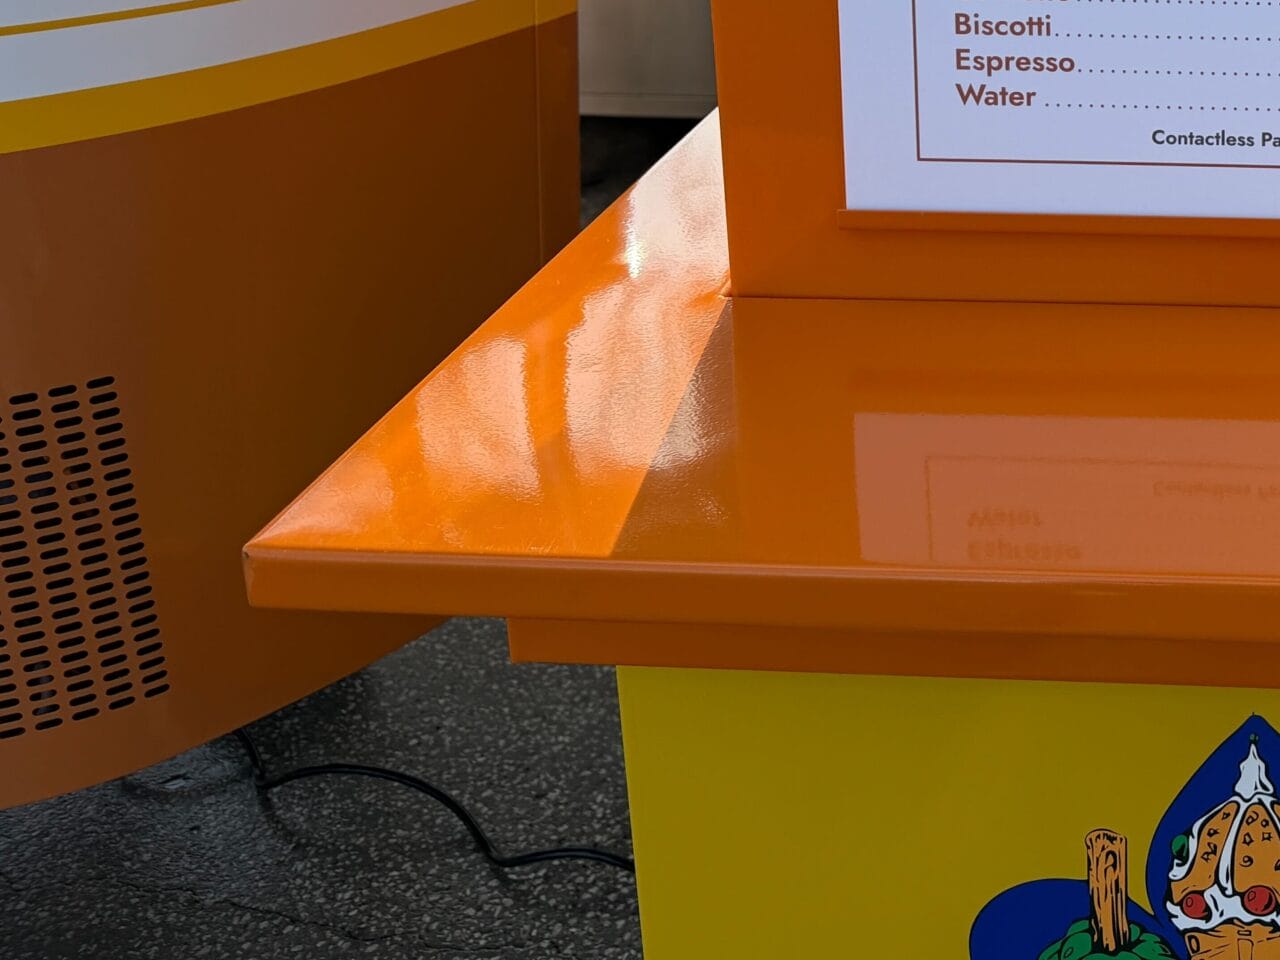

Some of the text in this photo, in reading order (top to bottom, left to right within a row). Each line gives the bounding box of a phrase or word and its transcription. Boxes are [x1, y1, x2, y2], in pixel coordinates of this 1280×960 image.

[954, 13, 1050, 36] Biscotti
[955, 49, 1075, 77] Espresso
[954, 84, 1036, 106] Water
[1151, 130, 1254, 146] Contactless
